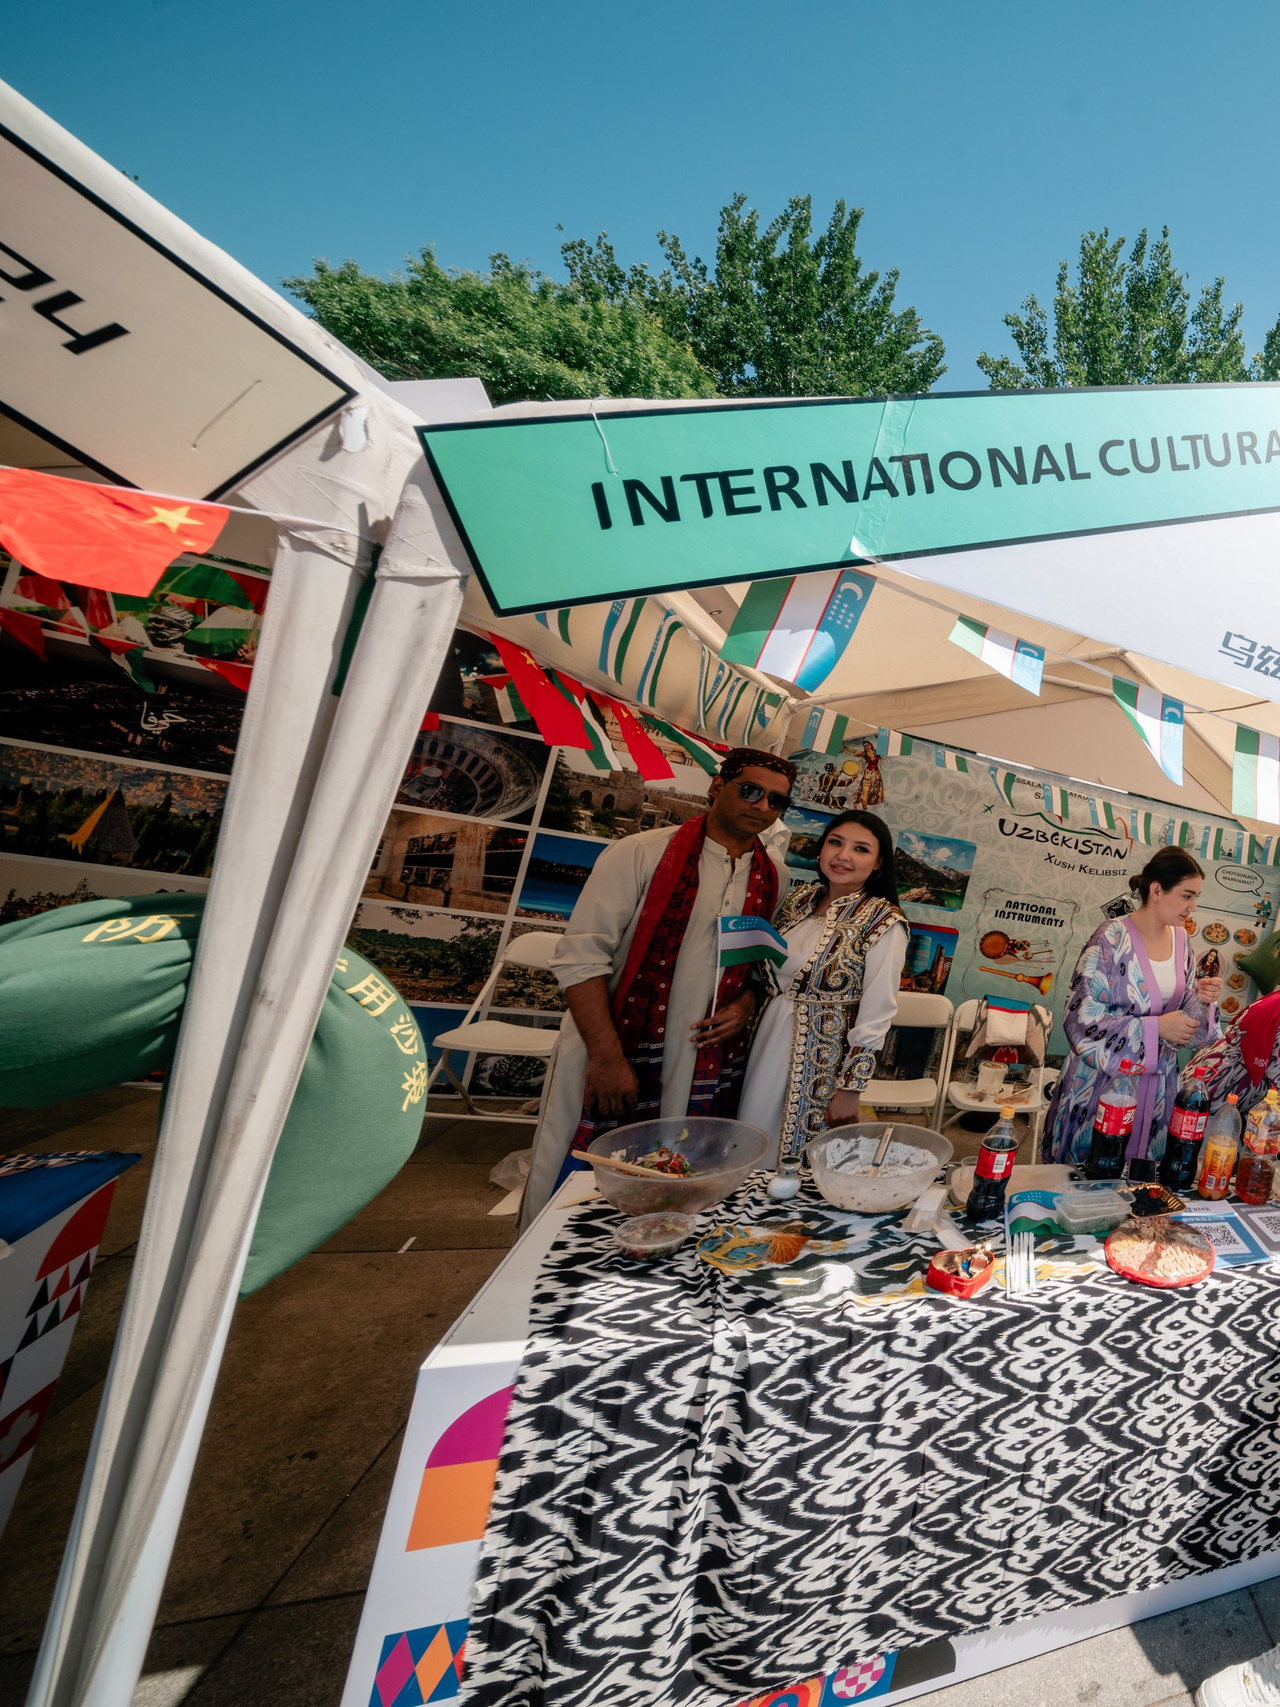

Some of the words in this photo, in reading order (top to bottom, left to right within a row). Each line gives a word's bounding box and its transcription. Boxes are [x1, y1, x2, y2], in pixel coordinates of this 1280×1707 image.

[590, 441, 1091, 530] INTERNATIONAL
[998, 818, 1128, 860] UZBEKISTAN
[994, 909, 1065, 929] INSTRUMENTS
[1005, 899, 1057, 917] NATIONAL
